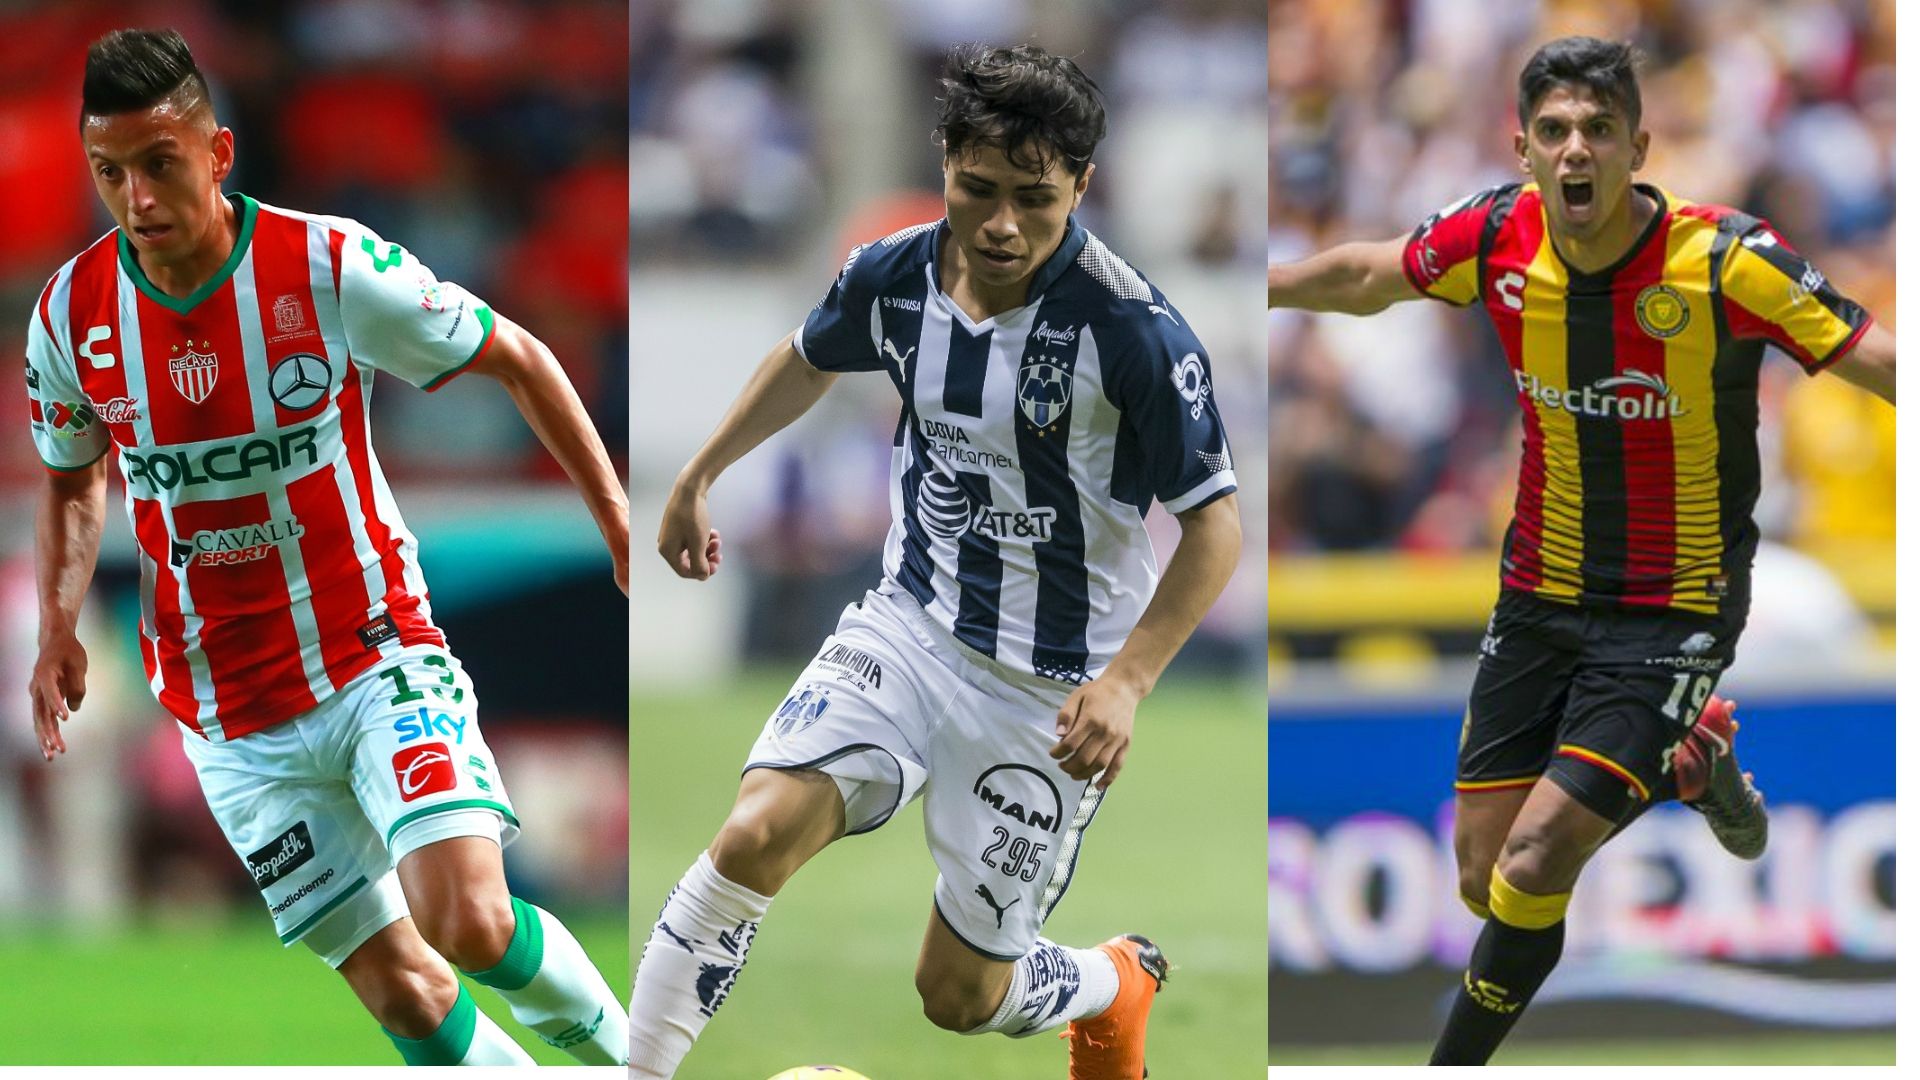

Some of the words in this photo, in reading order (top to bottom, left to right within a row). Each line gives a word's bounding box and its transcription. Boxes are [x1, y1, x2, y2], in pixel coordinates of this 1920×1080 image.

[892, 297, 921, 312] VIDUSA
[1033, 320, 1076, 347] Rayados
[172, 354, 215, 370] NECAXA
[925, 419, 970, 444] BBVA
[196, 520, 300, 552] CAVALL
[977, 508, 1052, 538] AT&T
[202, 543, 271, 566] SPORT
[1661, 673, 1712, 728] 19
[394, 707, 466, 745] sky
[980, 785, 1054, 831] MAN
[980, 825, 1047, 883] 295
